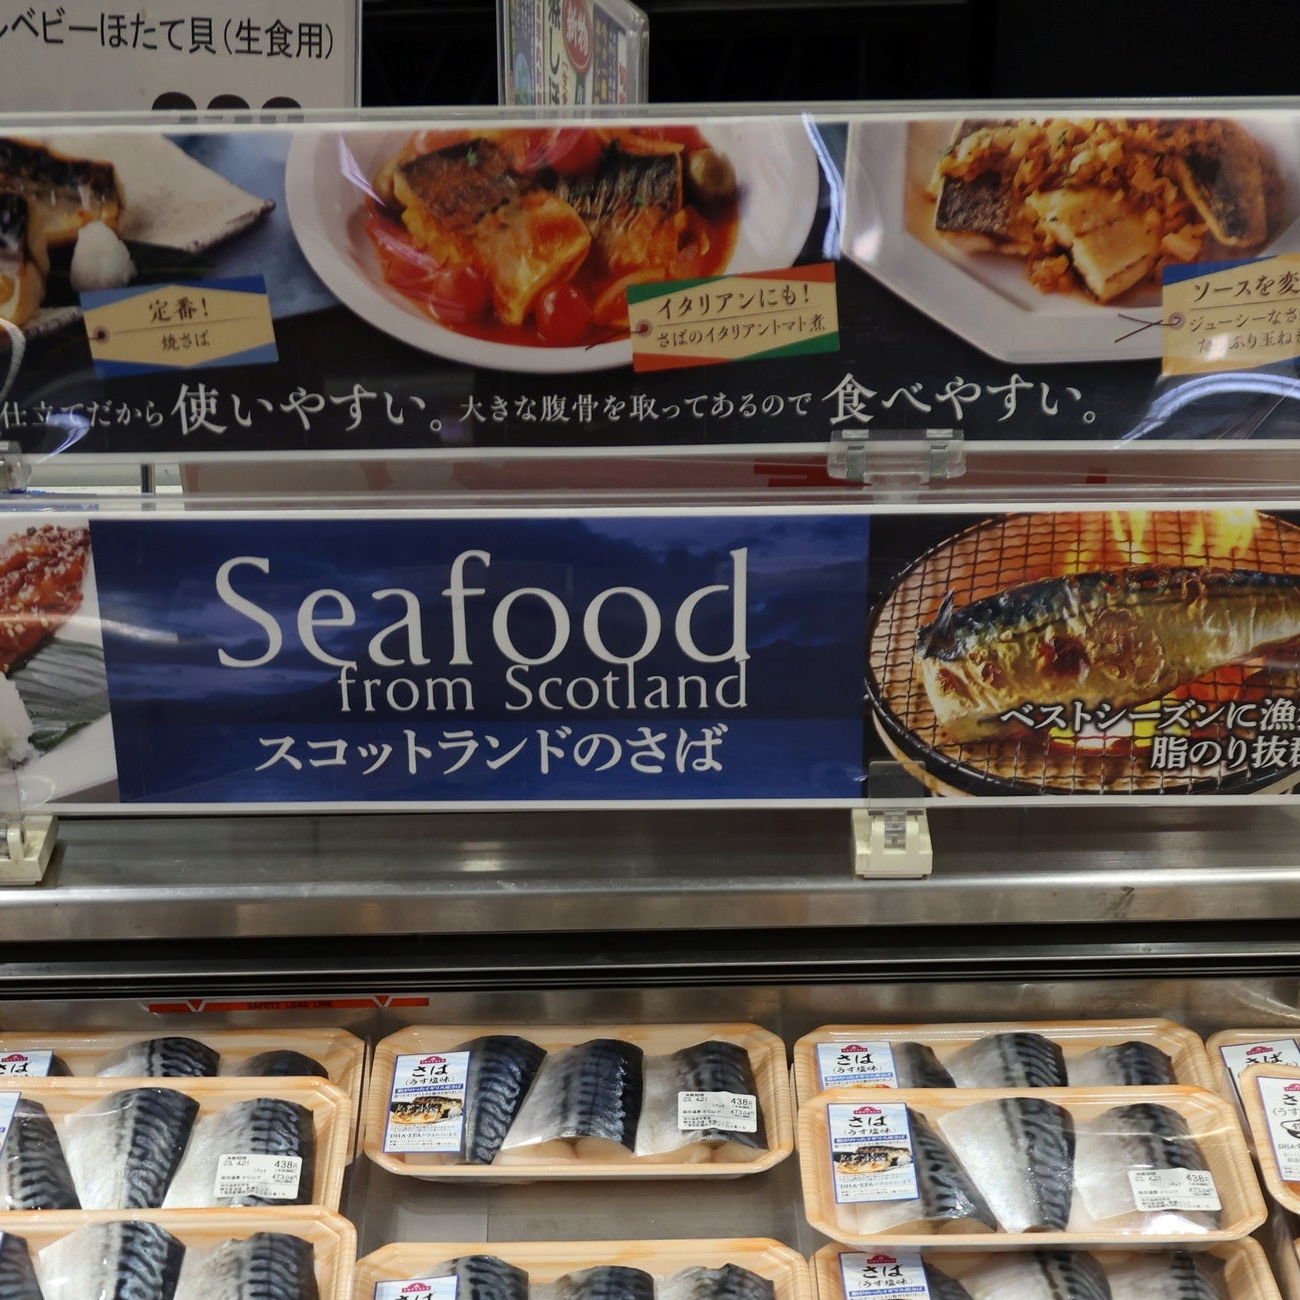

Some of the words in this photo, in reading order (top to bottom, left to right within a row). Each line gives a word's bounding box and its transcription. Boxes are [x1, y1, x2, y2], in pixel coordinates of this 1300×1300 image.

[656, 283, 810, 320] イタリアンにも!
[657, 313, 826, 350] さばのイタリアントマト煮
[161, 331, 210, 352] 焼さば
[215, 547, 751, 668] Seafood
[337, 663, 475, 712] from
[505, 660, 748, 711] Scotland
[255, 723, 729, 775] スコットランドのさば
[837, 1052, 875, 1066] さば
[413, 1063, 449, 1077] さば
[832, 1064, 883, 1074] (うす塩味)
[406, 1075, 455, 1086] (うす塩味)
[845, 1115, 887, 1128] さば
[843, 1126, 896, 1136] (うす塩味)
[862, 1264, 904, 1278] さば
[857, 1276, 913, 1288] (うす塩味)
